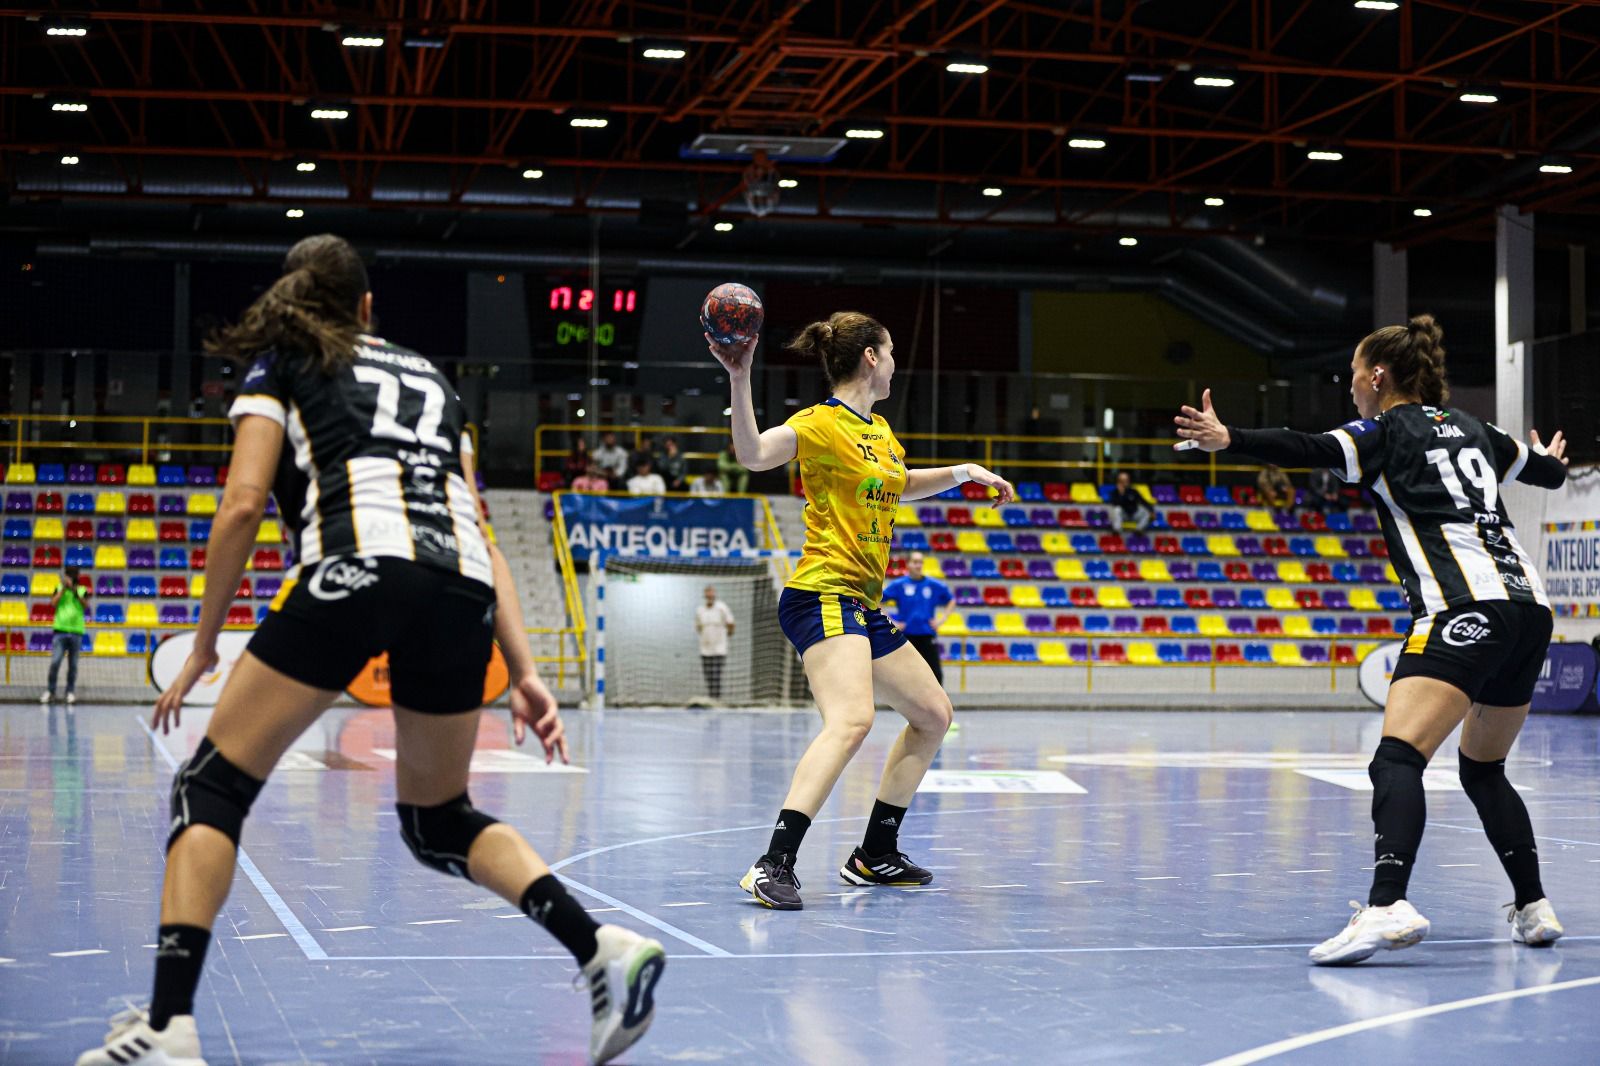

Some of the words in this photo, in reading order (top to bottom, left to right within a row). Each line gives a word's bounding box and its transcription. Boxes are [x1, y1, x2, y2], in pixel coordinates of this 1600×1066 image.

[579, 289, 594, 310] 2
[614, 290, 636, 312] 11
[1433, 423, 1465, 438] LIMA
[857, 443, 879, 463] 25
[1425, 447, 1498, 511] 19
[568, 523, 751, 553] ANTEQUERA
[1452, 621, 1491, 640] CSIF
